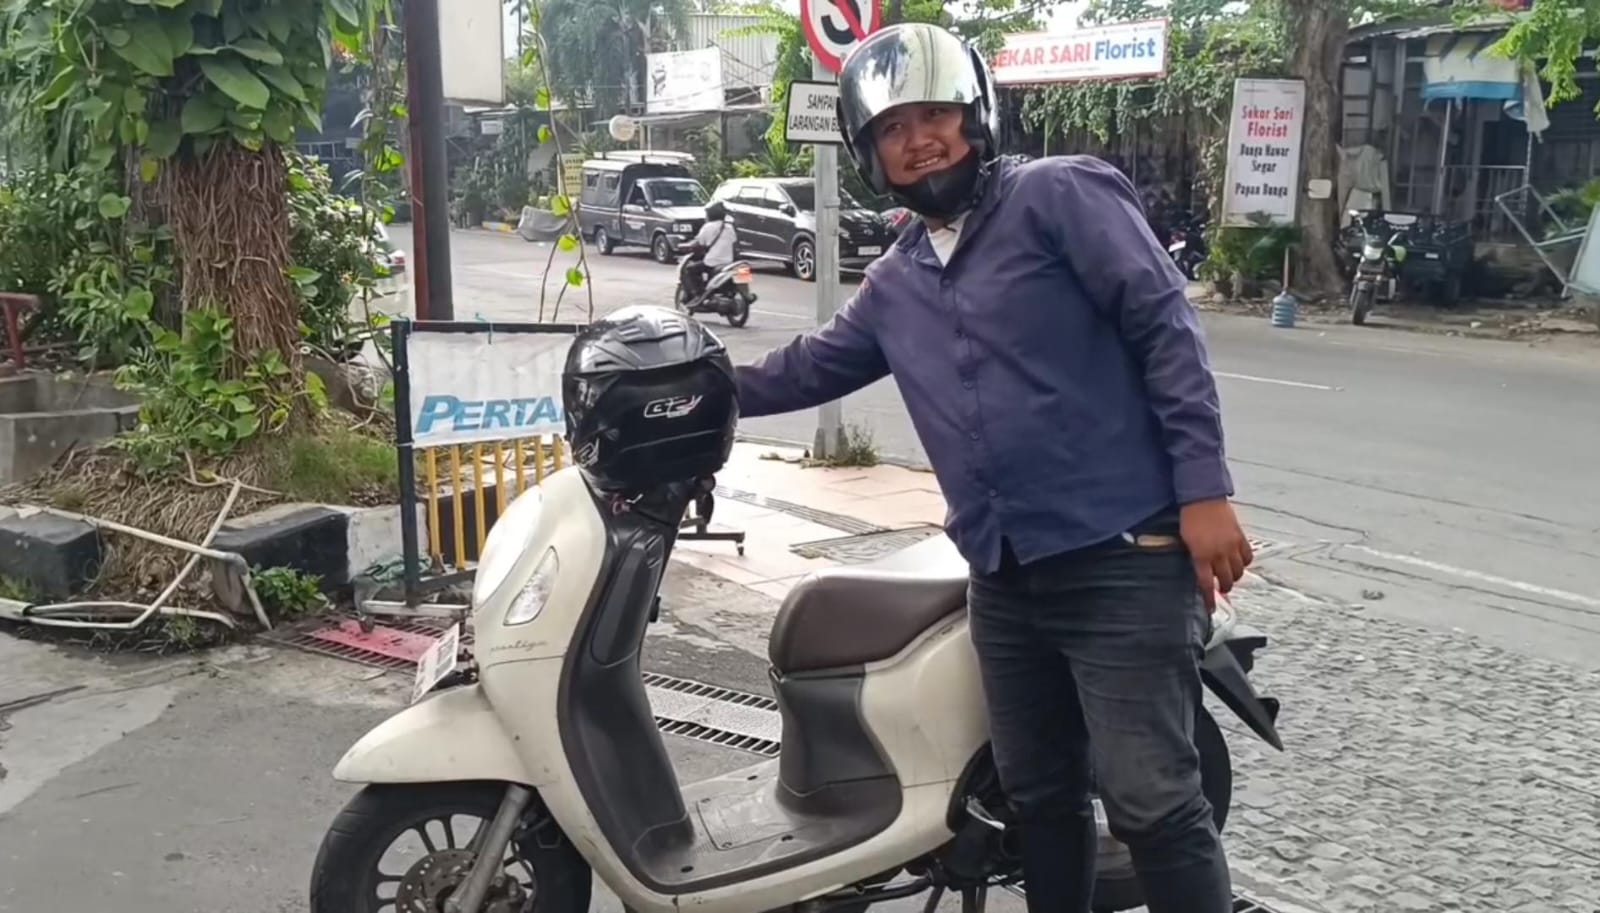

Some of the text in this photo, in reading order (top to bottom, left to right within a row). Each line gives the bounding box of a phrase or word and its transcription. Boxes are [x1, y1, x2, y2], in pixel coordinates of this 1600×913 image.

[1049, 42, 1091, 64] SARI
[1094, 38, 1155, 61] Florist
[1241, 105, 1293, 120] Sekar Sari
[789, 115, 830, 131] LARANGAN
[1248, 122, 1287, 137] Florist
[1252, 160, 1276, 174] Segar
[1235, 182, 1288, 198] Papan Bunga
[414, 394, 564, 434] PERTA
